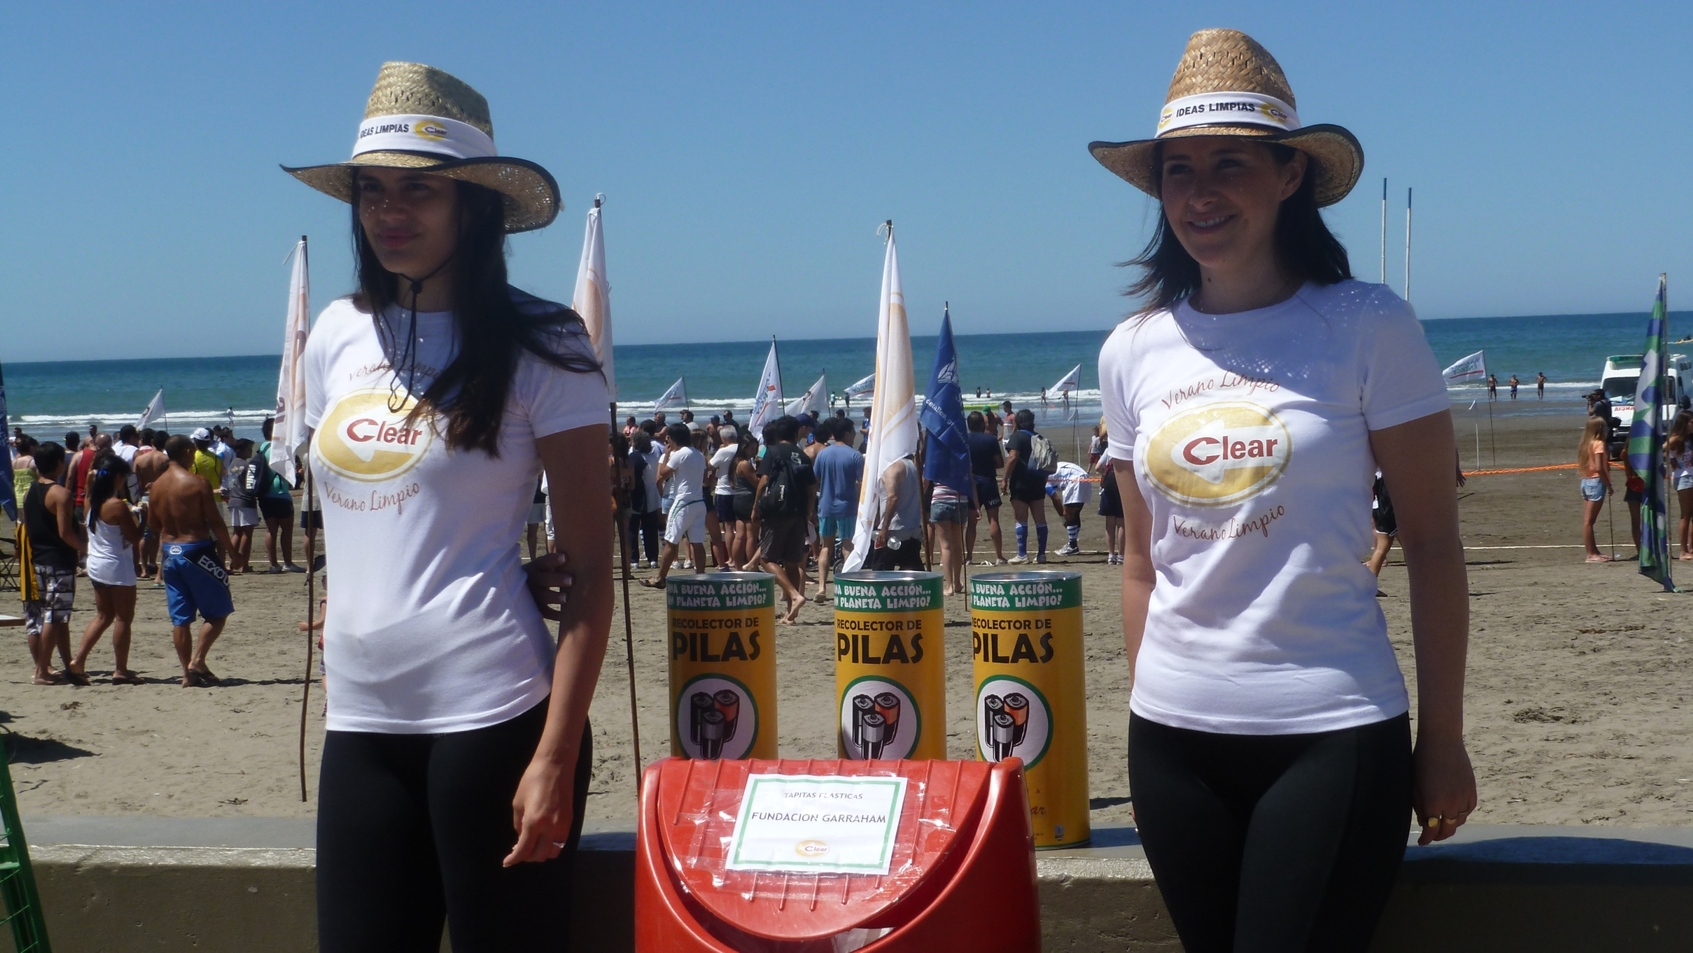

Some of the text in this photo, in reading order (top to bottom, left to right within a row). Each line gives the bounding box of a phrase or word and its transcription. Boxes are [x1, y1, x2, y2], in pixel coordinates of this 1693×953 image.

[1176, 102, 1256, 118] IDEAS LIMPIAS
[374, 123, 410, 135] LIMPIAS
[424, 126, 448, 136] Clear
[1161, 368, 1281, 410] Verano Limpio
[346, 418, 423, 446] Clear
[1182, 435, 1278, 466] Clear
[323, 481, 421, 516] Verano Limpio
[1172, 505, 1285, 541] Verano Limpio
[681, 584, 716, 595] BUENA
[720, 582, 767, 596] ACCIÓN...
[844, 585, 877, 597] BUENA
[881, 583, 932, 597] ACCIÓN...
[975, 583, 1005, 596] BUENA
[1009, 582, 1063, 596] ACCIÓN...
[676, 596, 721, 608] PLANETA
[725, 594, 767, 607] LIMPIO!
[840, 597, 882, 609] PLANETA
[886, 596, 932, 609] LIMPIO!
[973, 595, 1011, 608] PLANETA
[1015, 594, 1063, 608] LIMPIO!
[672, 617, 759, 630] RECOLECTOR DE
[837, 619, 922, 631] RECOLECTOR DE
[1035, 618, 1052, 629] DE
[672, 629, 761, 663] PILAS
[837, 632, 924, 665] PILAS
[972, 631, 1055, 664] PILAS
[784, 791, 816, 800] TAPITAS
[751, 811, 886, 824] FUNDACION GARRAHAM
[804, 845, 828, 853] Clear
